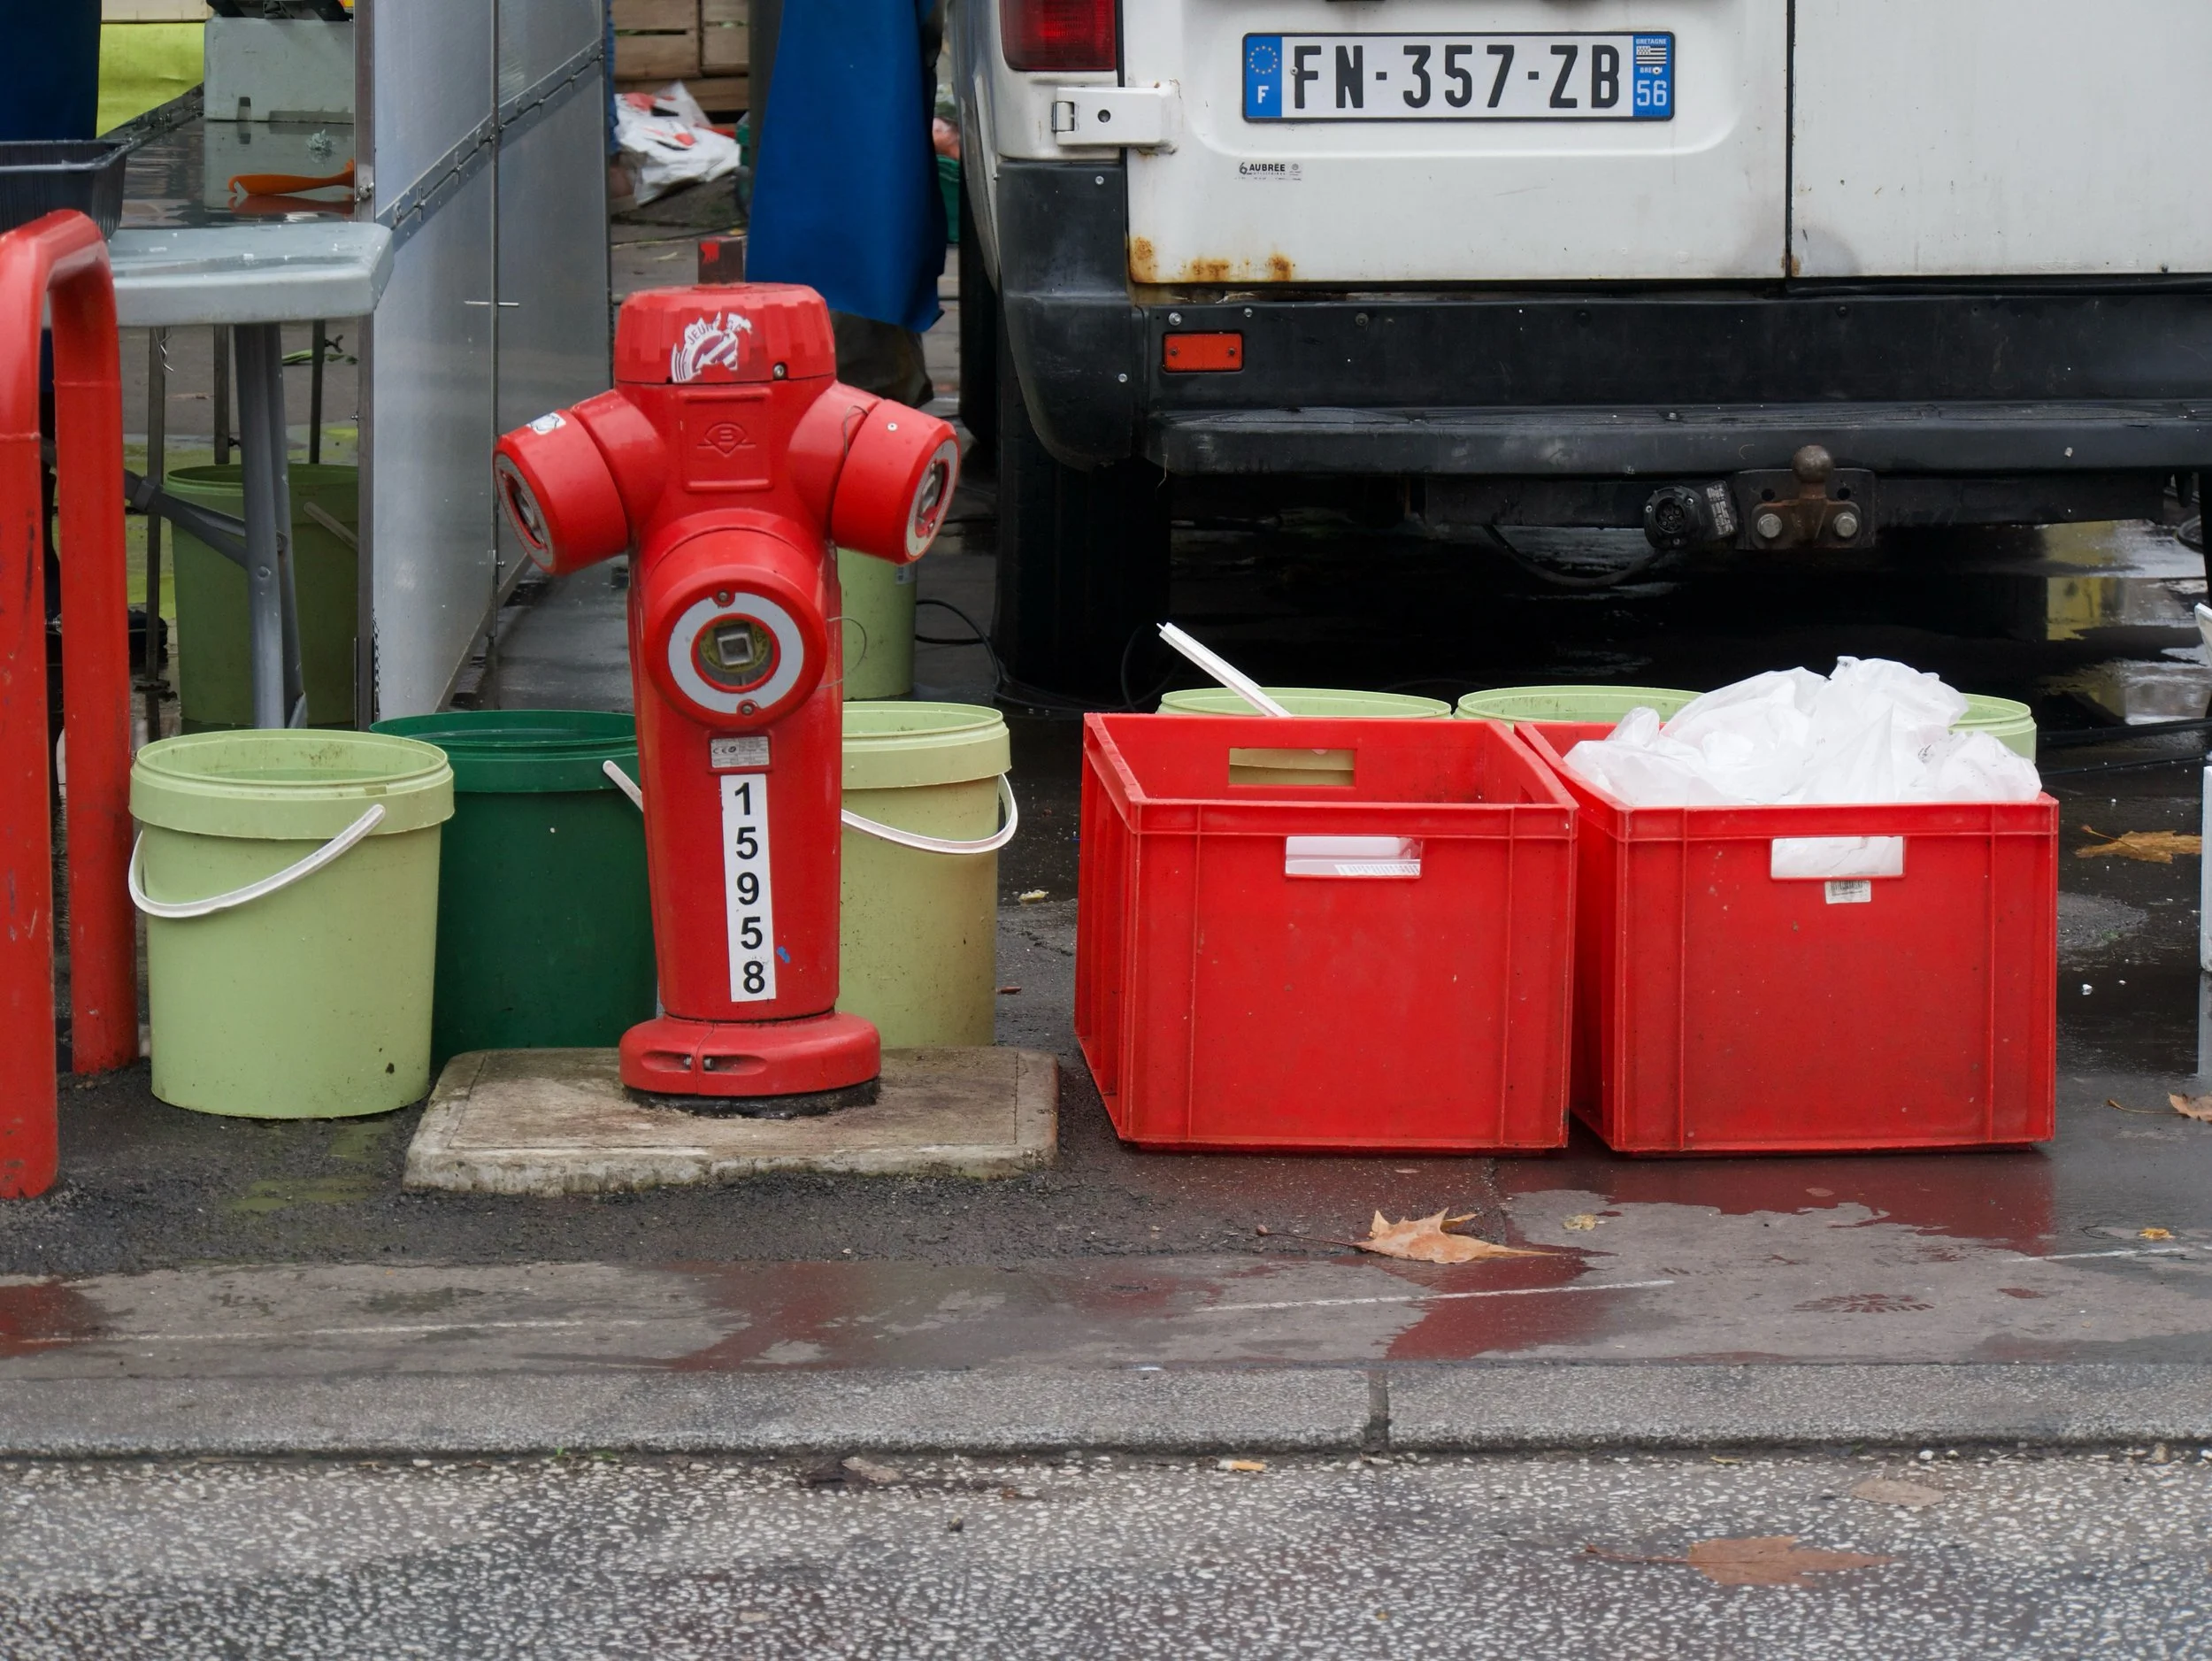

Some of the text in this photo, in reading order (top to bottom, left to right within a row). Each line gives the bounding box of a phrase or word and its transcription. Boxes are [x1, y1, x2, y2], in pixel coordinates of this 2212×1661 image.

[1257, 85, 1270, 104] F
[1294, 44, 1620, 109] FN-357-ZB
[1636, 80, 1667, 106] 56
[734, 782, 765, 995] 15958
